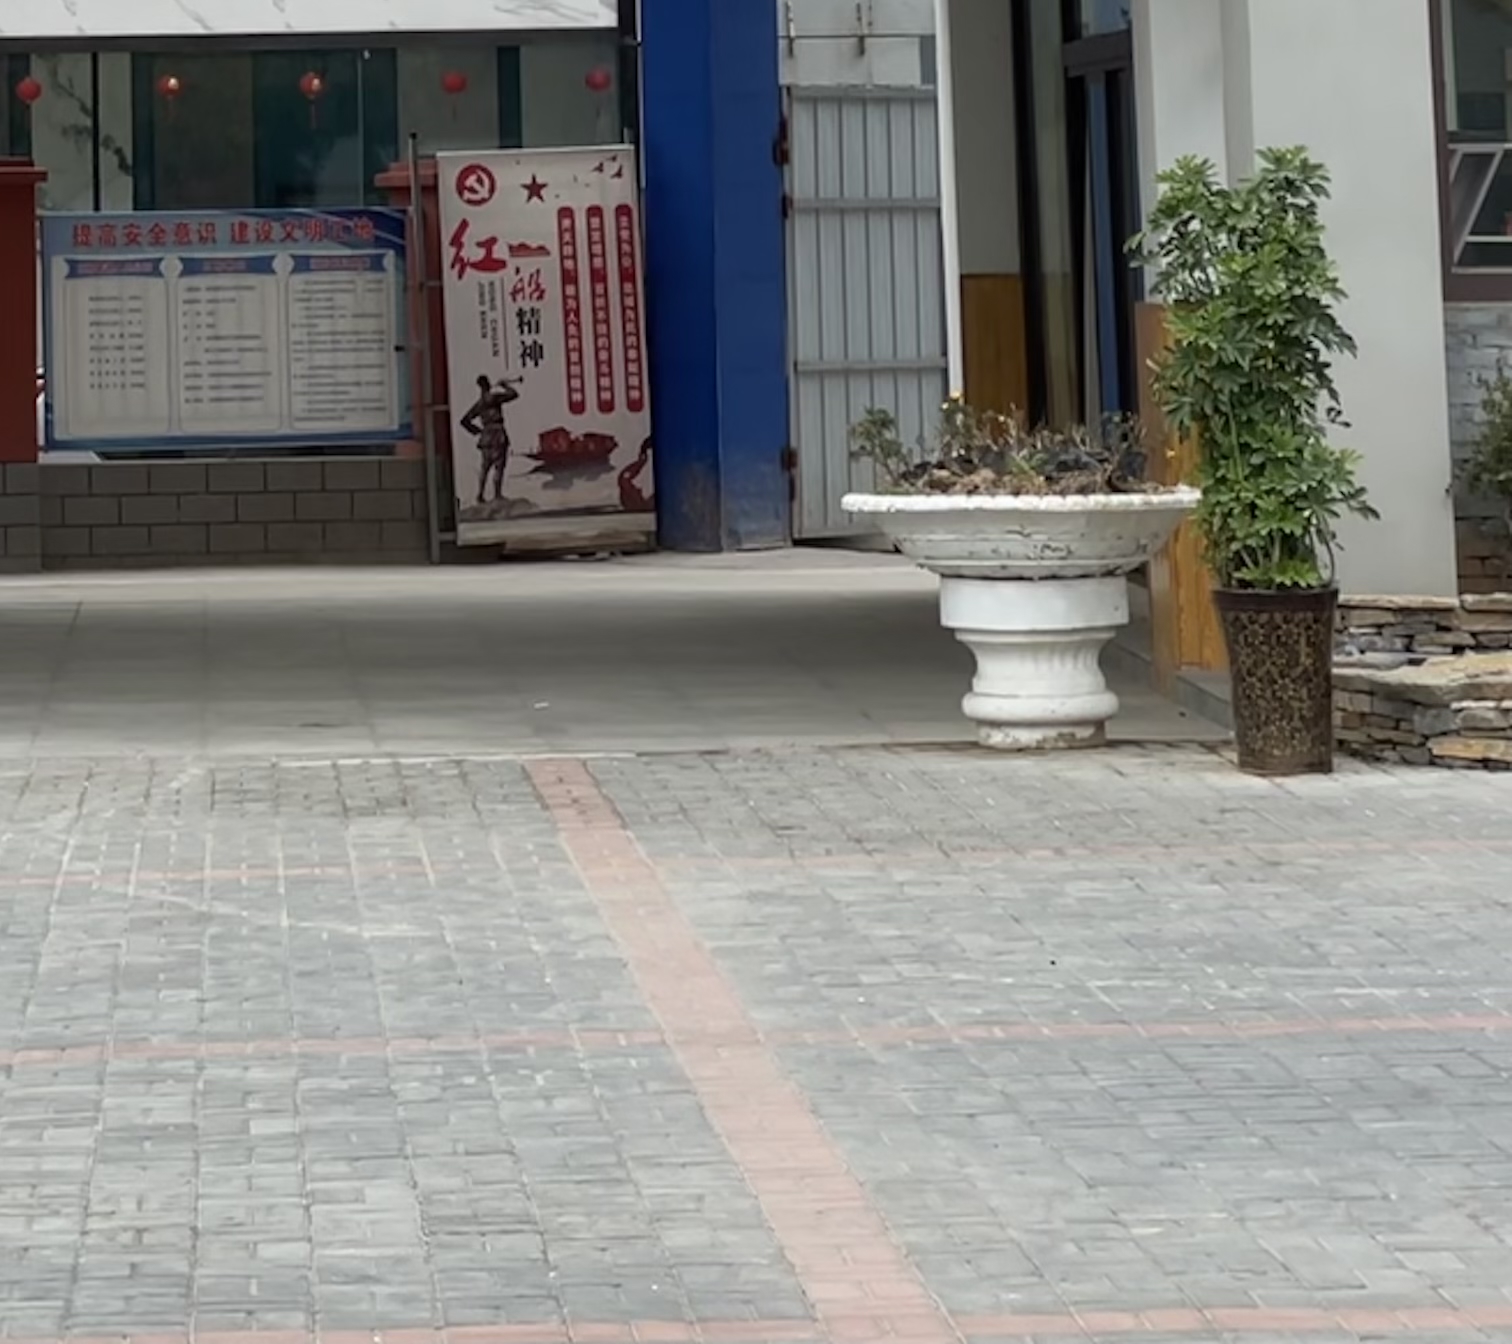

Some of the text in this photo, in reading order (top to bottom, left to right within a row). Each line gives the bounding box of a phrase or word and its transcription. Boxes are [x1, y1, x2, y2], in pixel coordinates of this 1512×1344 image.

[73, 222, 217, 248] 提高安全意识
